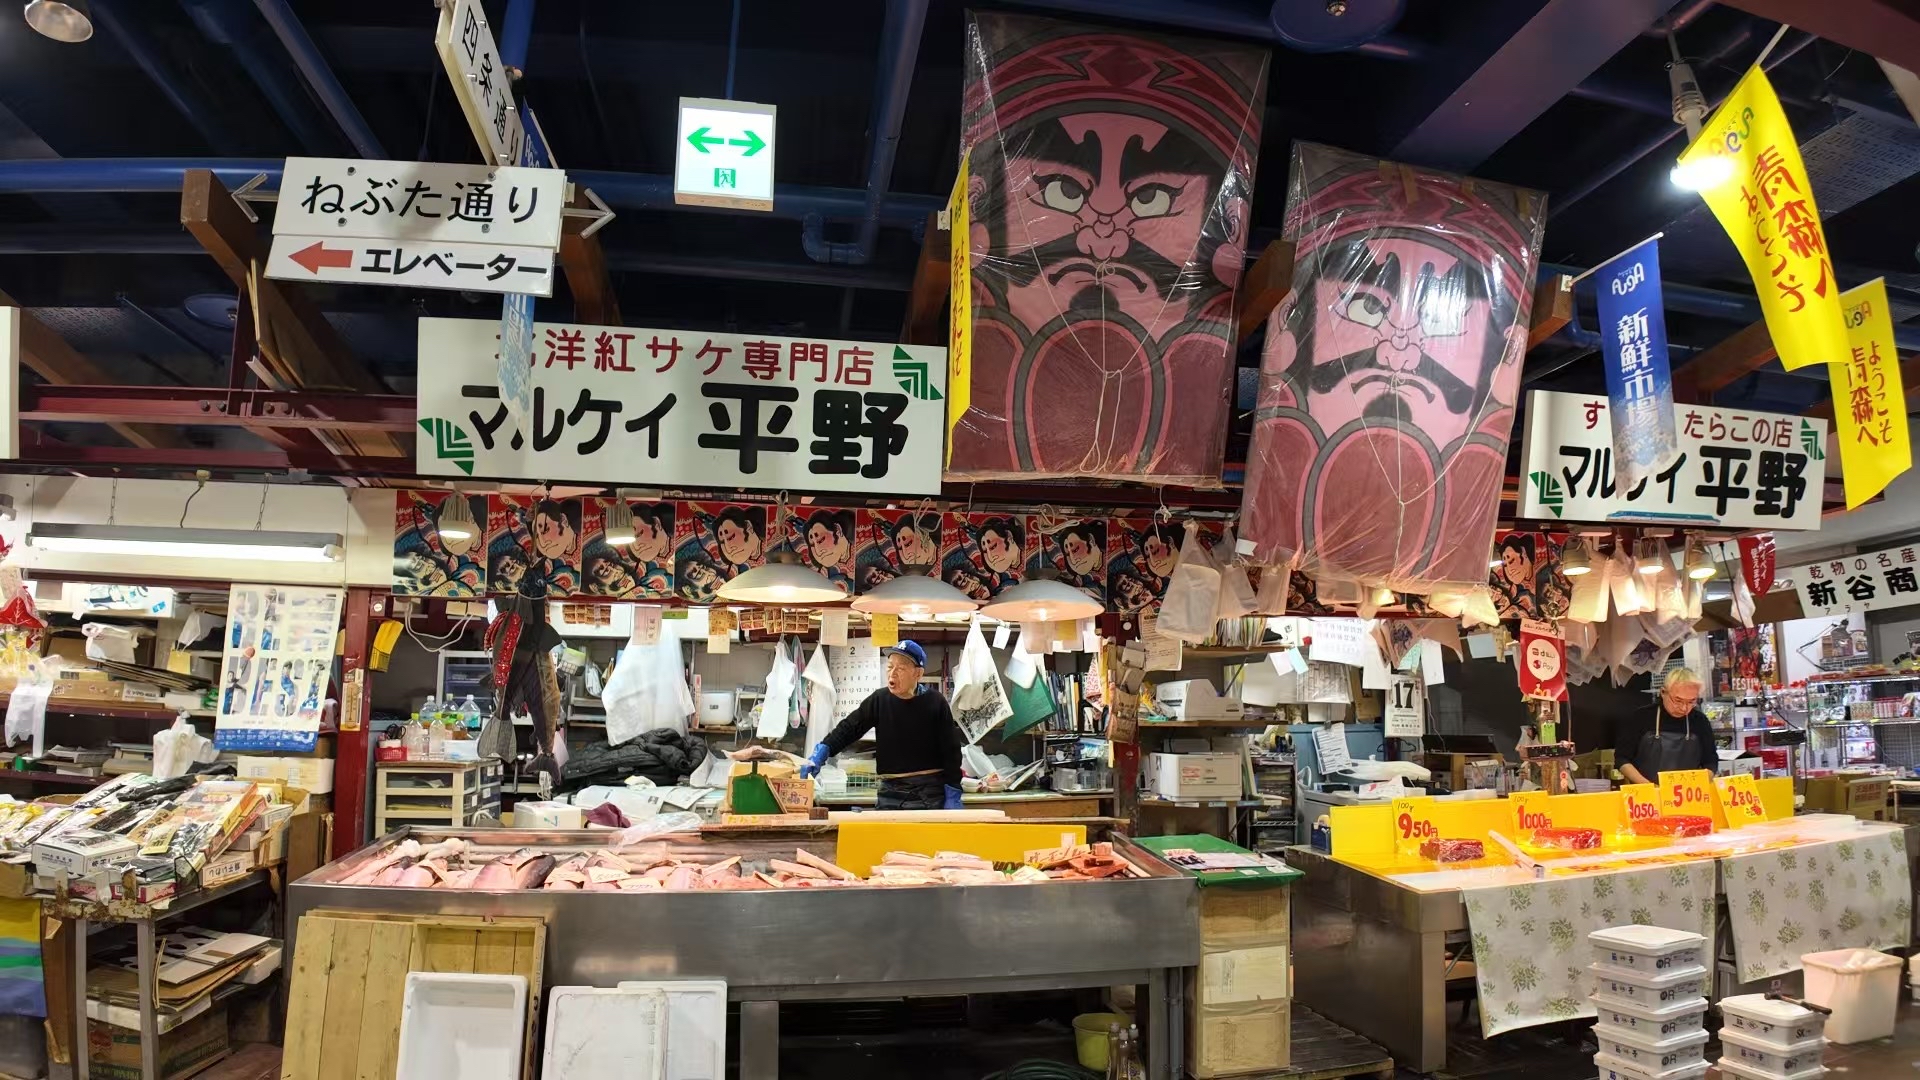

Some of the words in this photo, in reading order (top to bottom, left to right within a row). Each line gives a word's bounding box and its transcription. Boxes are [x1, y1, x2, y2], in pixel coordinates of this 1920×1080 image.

[462, 4, 519, 166] 四条通り
[301, 175, 538, 224] ねぶた通り
[360, 247, 548, 281] エレベーター
[1616, 306, 1659, 428] 新鮮市場
[1868, 340, 1893, 444] ようこそ
[1809, 547, 1918, 580] 乾物の名産
[849, 646, 856, 655] 2
[1394, 682, 1415, 709] 17
[1627, 796, 1660, 819] 1050円
[1673, 784, 1710, 808] 500円
[1727, 785, 1761, 807] 280円
[1397, 812, 1439, 839] 950円
[1516, 804, 1553, 830] 1000円
